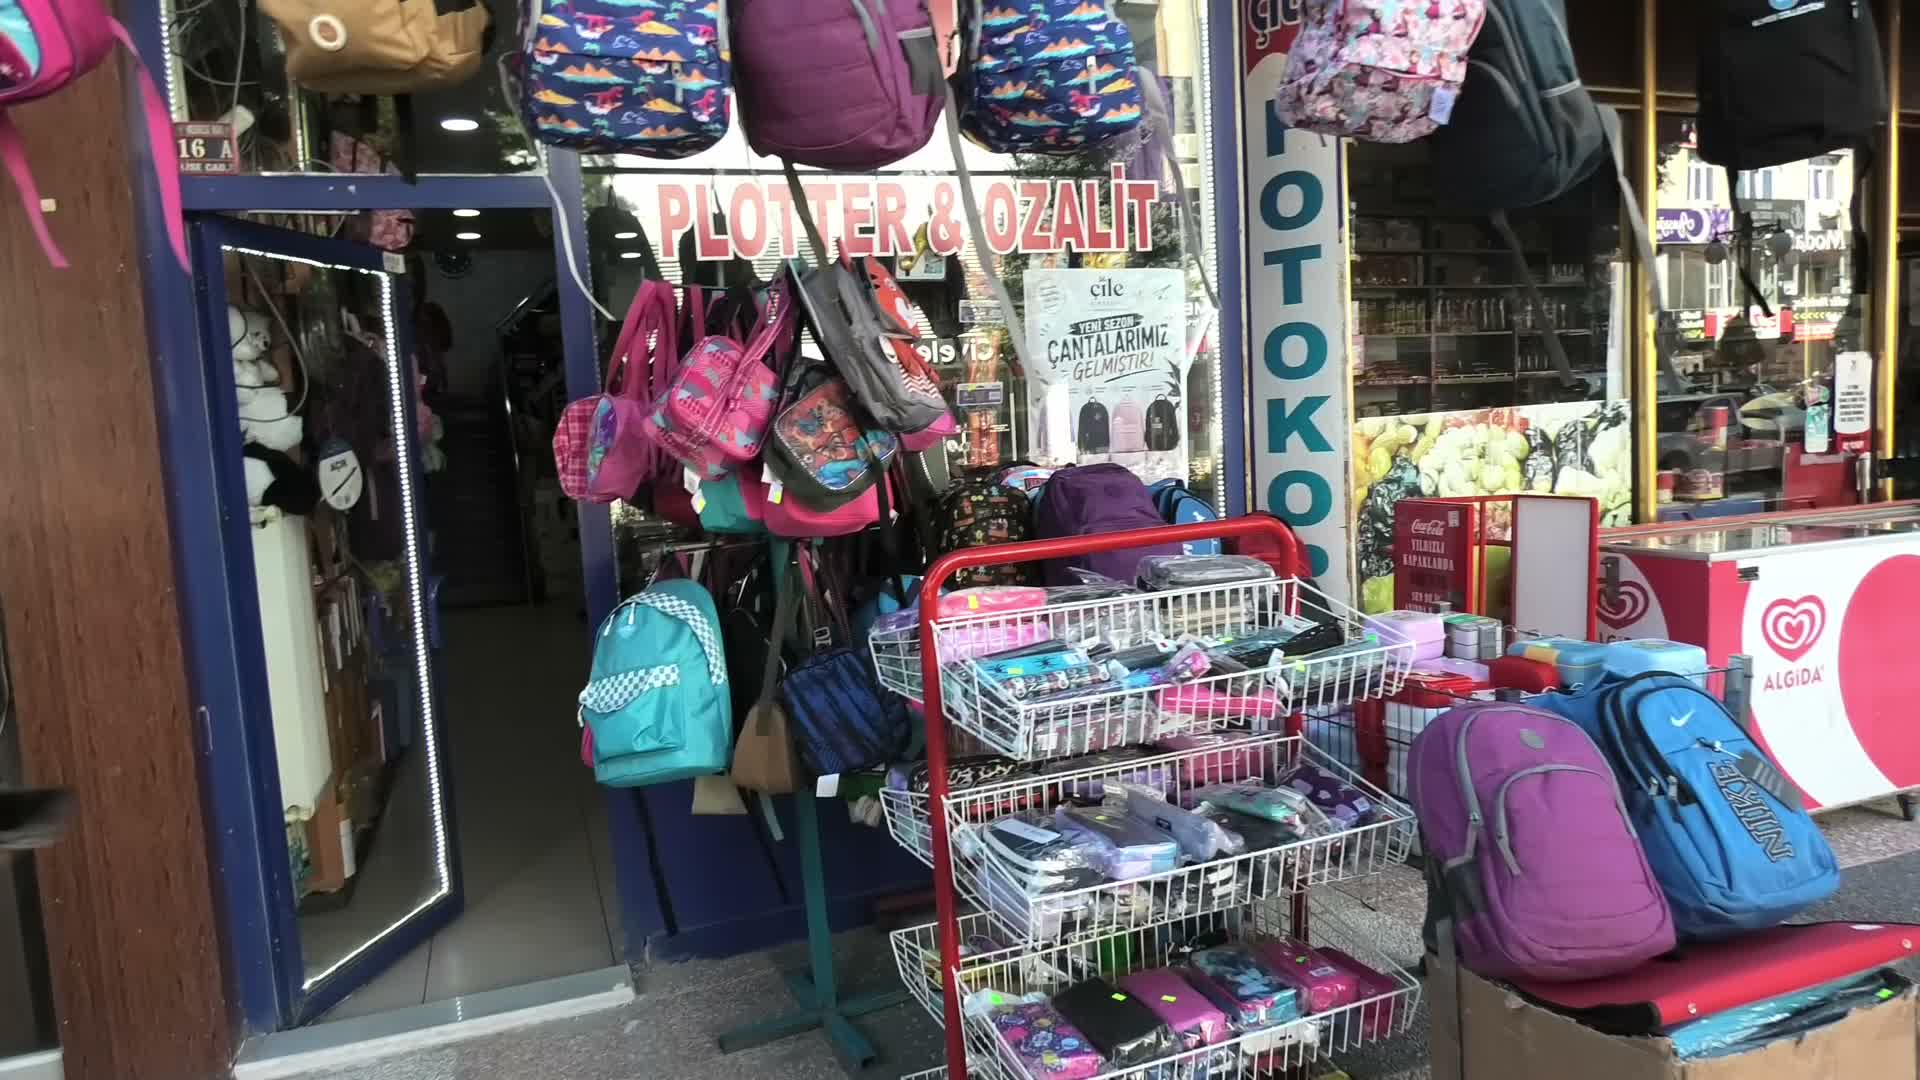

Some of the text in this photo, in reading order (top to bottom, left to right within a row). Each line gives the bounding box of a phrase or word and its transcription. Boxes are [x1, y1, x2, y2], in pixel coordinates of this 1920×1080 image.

[178, 138, 233, 158] 16 A
[657, 163, 1158, 261] PLOTTER & OZALİT
[1047, 323, 1169, 369] ÇANTALARIMIZ
[1104, 315, 1135, 332] SEZON
[1706, 760, 1795, 863] NIKE
